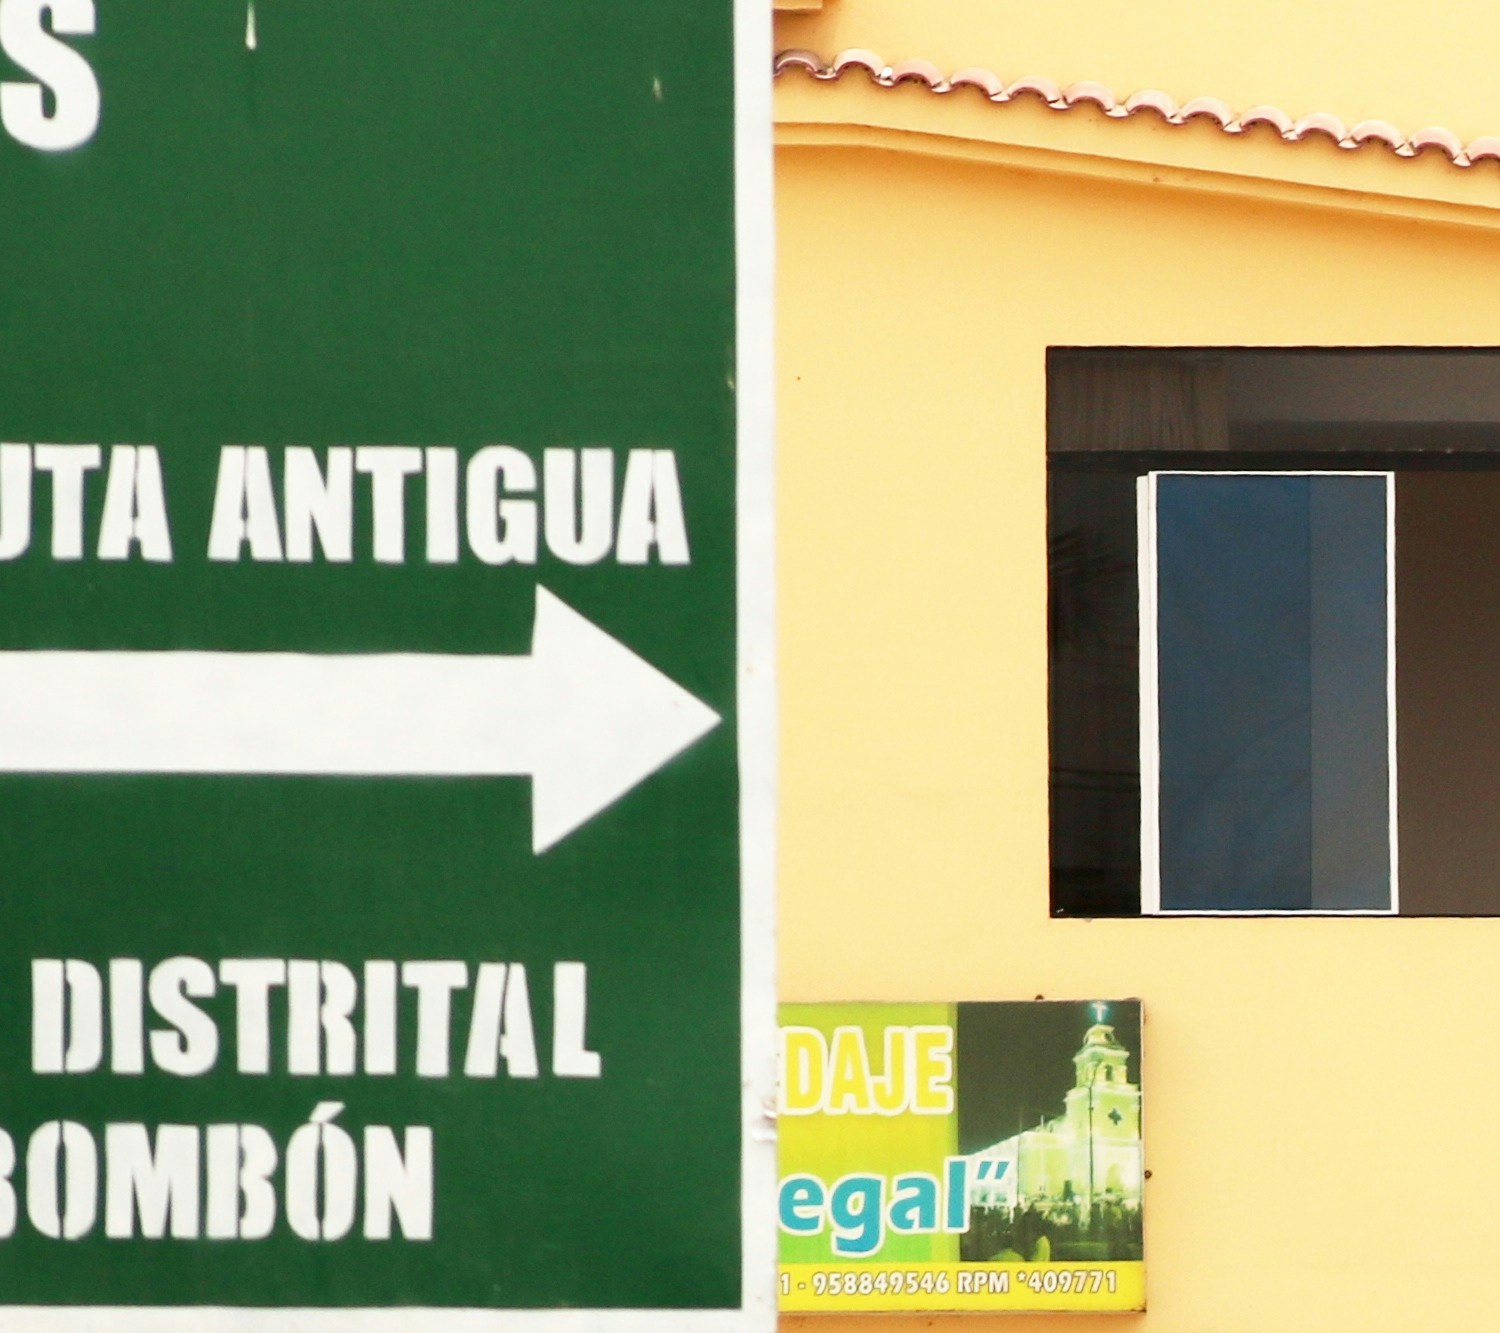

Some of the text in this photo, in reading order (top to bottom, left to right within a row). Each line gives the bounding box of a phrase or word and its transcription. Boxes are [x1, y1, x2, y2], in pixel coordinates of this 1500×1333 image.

[207, 445, 691, 565] ANTIGUA
[31, 956, 601, 1078] DISTRITAL
[781, 1026, 954, 1115] DAJE
[0, 1101, 434, 1242] OMBÓN
[812, 1271, 950, 1296] 958849546
[957, 1270, 1009, 1293] RPM
